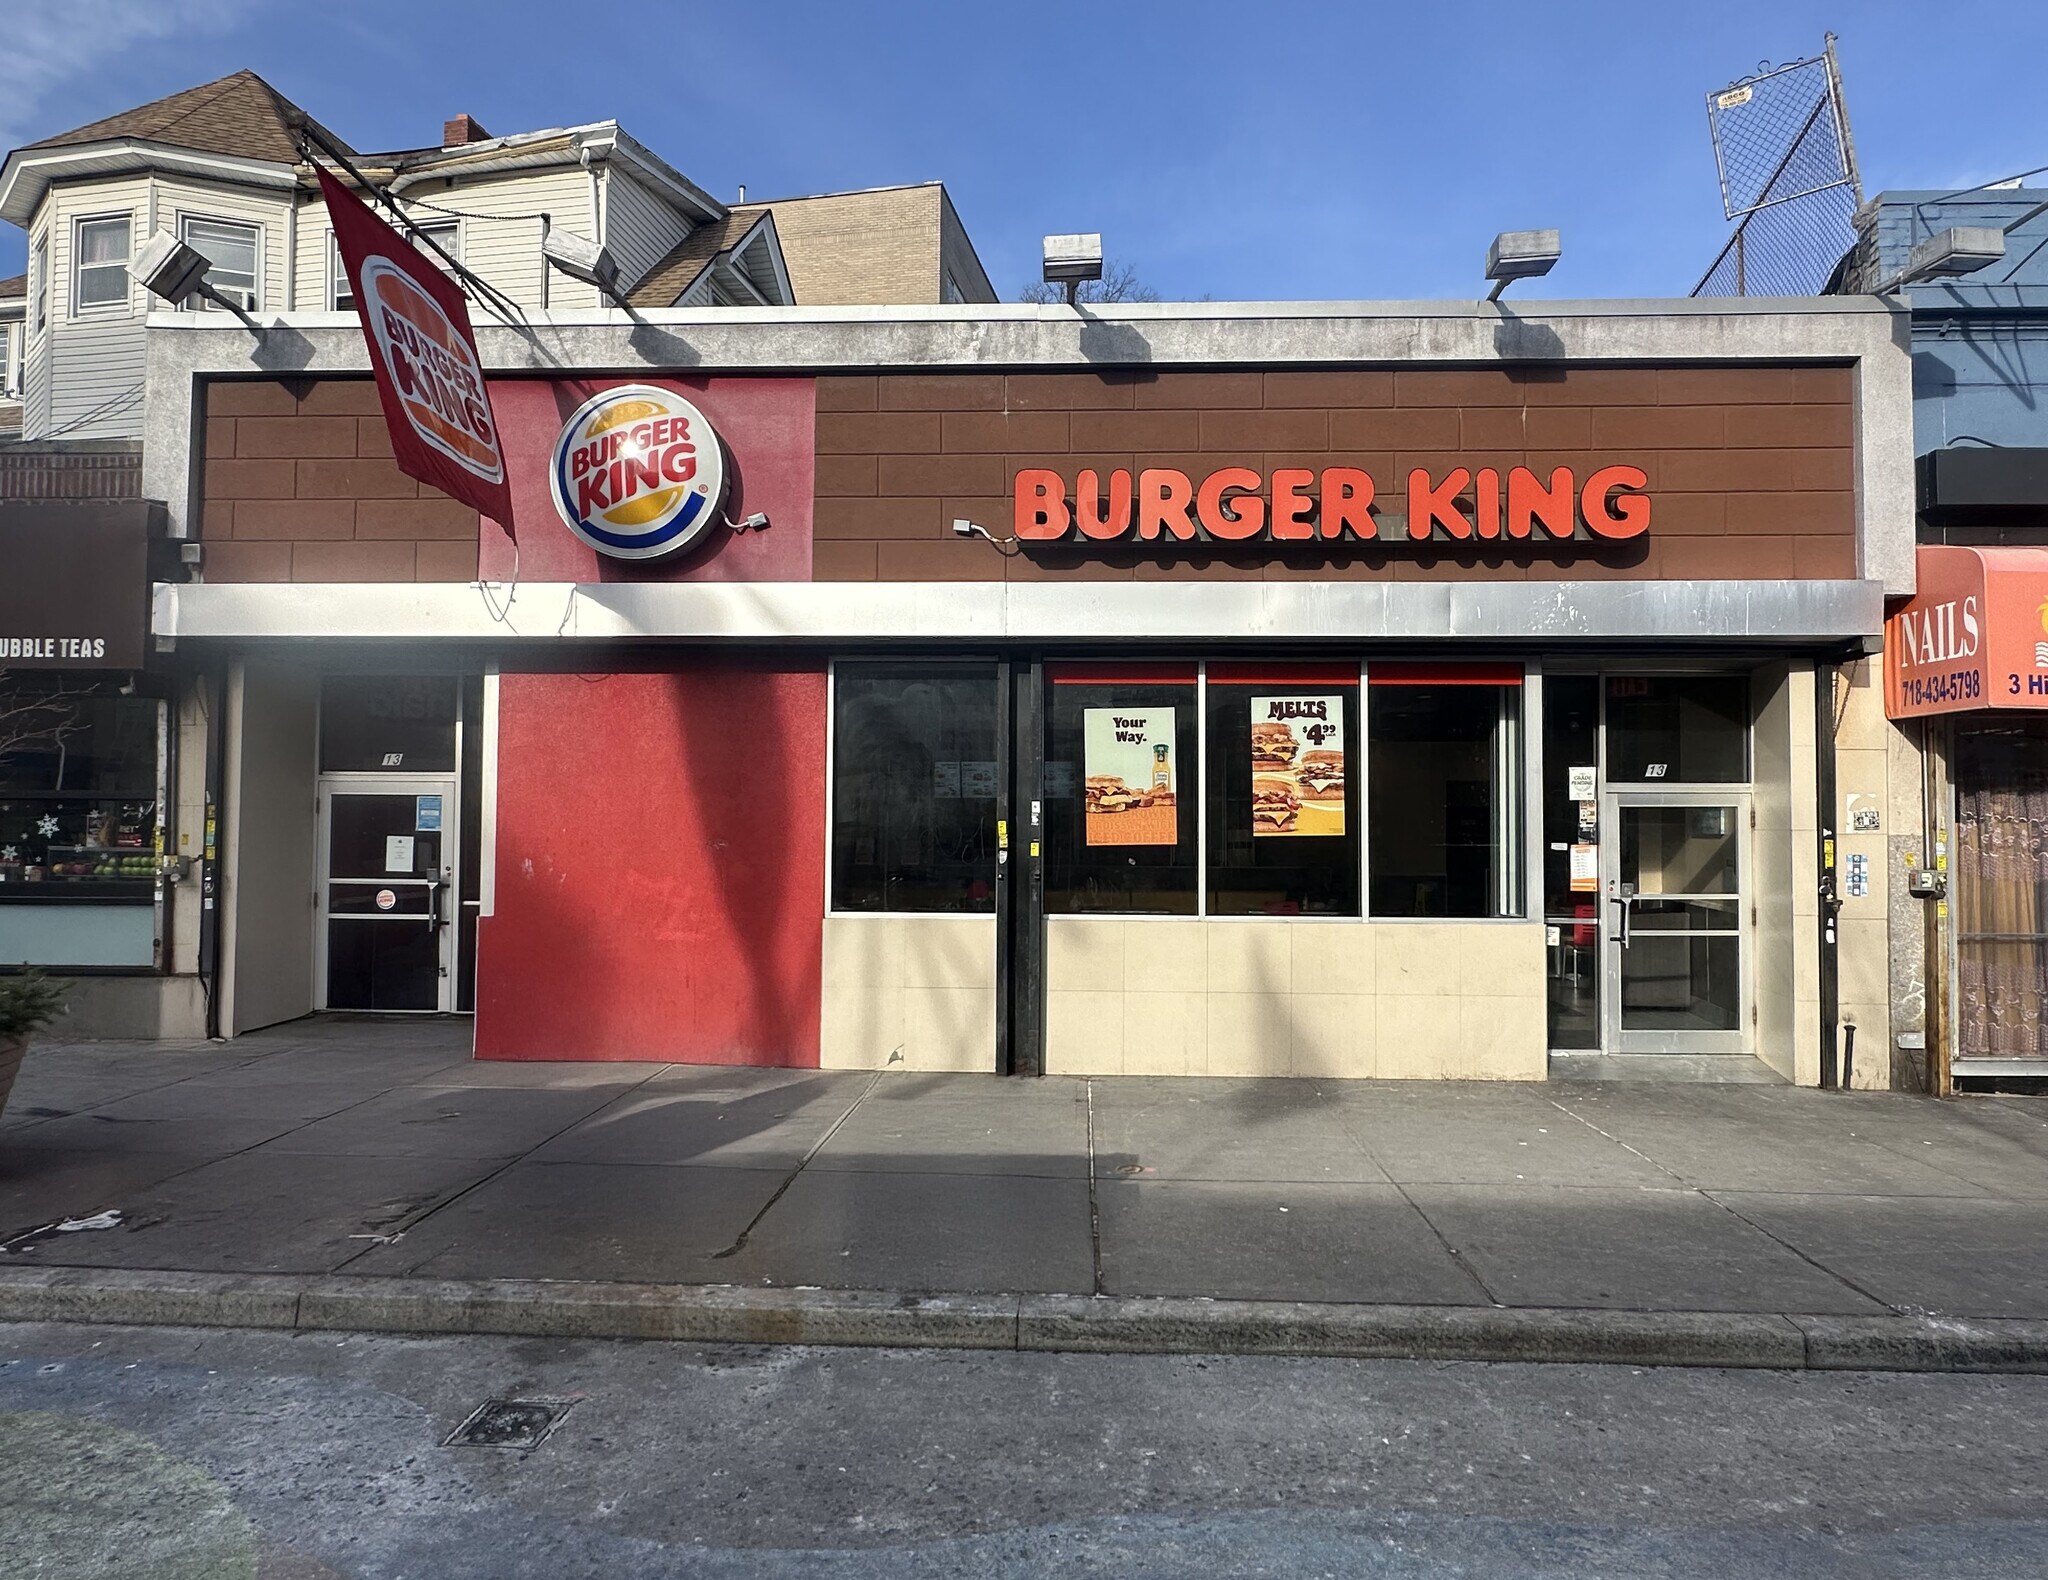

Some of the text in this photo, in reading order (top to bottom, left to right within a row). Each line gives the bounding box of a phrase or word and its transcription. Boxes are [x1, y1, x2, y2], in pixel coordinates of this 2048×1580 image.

[382, 305, 482, 402] BURGER
[390, 343, 492, 445] KING
[572, 417, 691, 480] BURGER
[578, 443, 697, 520] KING
[1013, 464, 1653, 542] BURGER KING
[1901, 595, 1979, 668] NAILS
[59, 638, 105, 658] TEAS
[1902, 669, 1980, 707] 718-434-5798
[2008, 673, 2021, 694] 3
[1112, 717, 1147, 728] Your
[1267, 700, 1327, 721] MELTS
[1115, 731, 1147, 745] Way.
[385, 754, 401, 765] 13
[1649, 764, 1665, 775] 13
